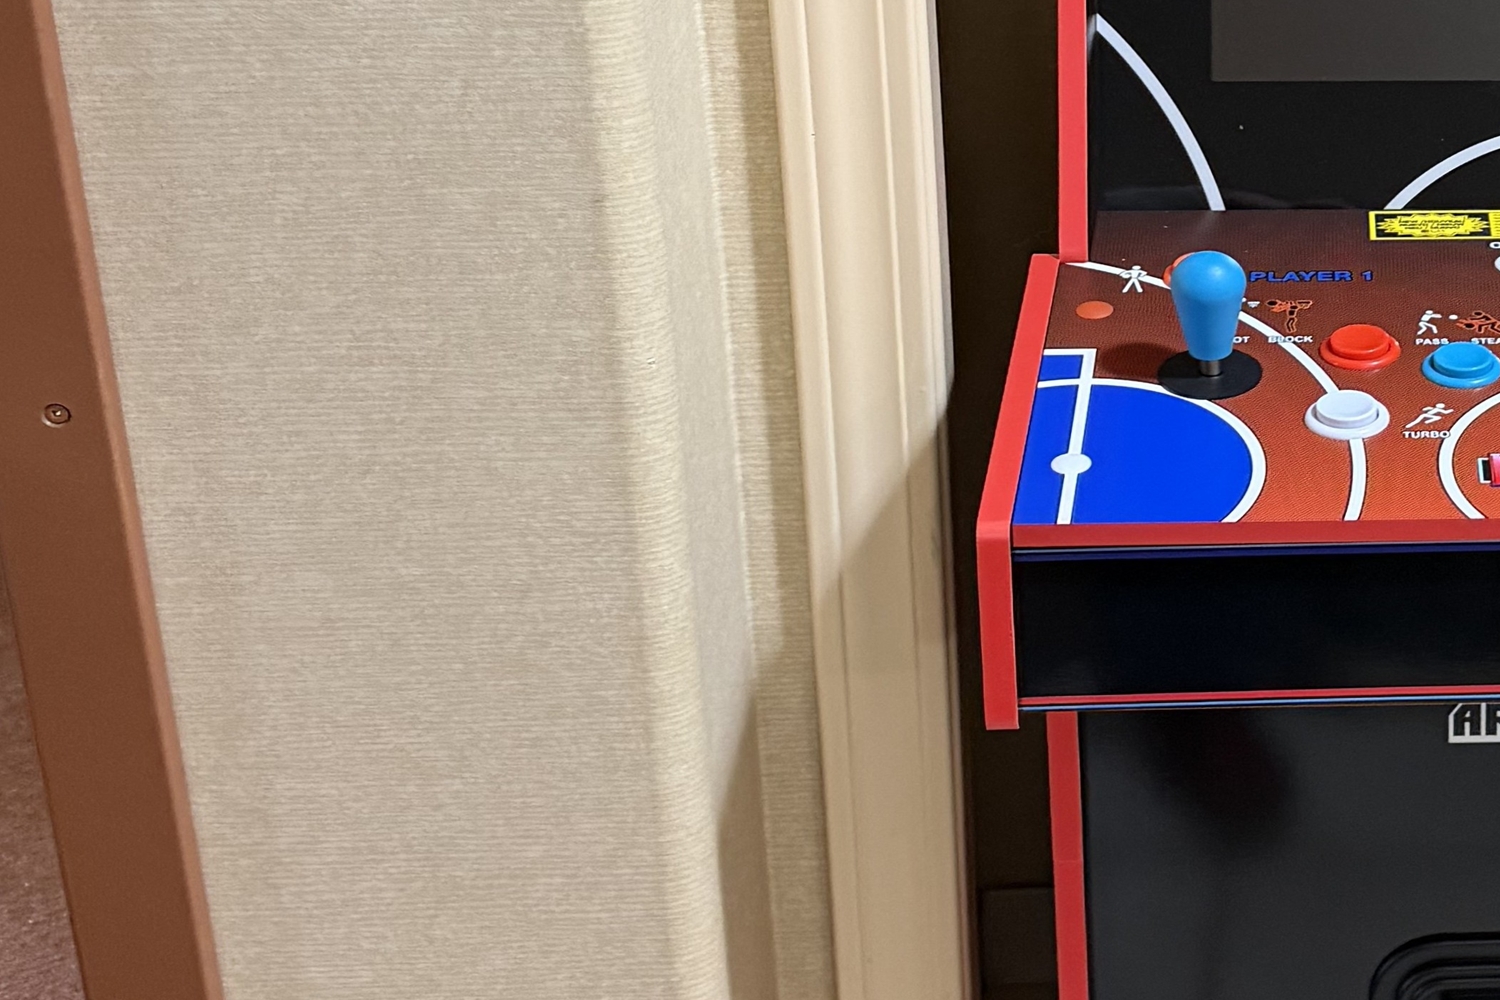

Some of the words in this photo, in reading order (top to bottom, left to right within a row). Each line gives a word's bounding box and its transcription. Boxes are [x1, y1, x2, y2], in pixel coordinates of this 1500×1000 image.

[1249, 271, 1353, 282] PLAYER
[1360, 270, 1374, 282] 1
[1267, 335, 1314, 344] BLOCK
[1415, 337, 1450, 346] PASS
[1402, 430, 1450, 439] TURBO
